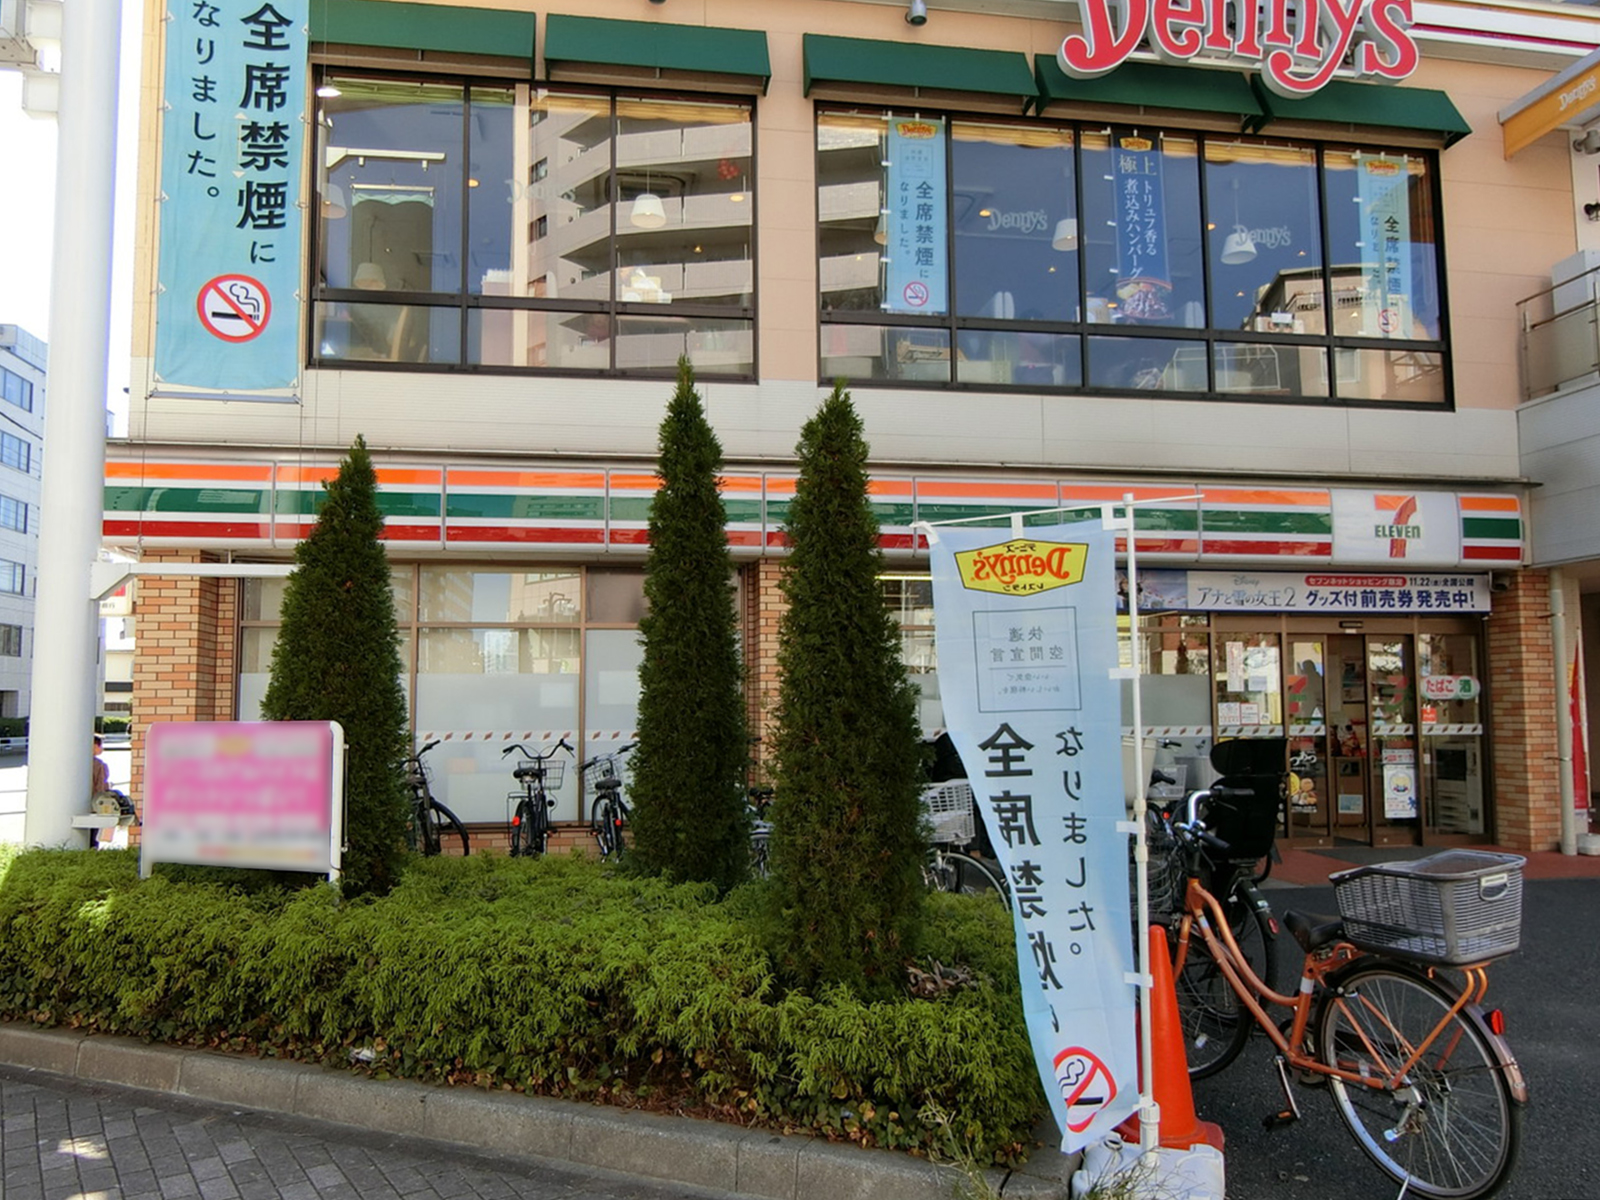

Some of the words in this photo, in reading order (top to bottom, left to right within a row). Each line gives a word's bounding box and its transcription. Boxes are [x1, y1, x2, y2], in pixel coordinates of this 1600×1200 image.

[1057, 0, 1420, 97] Dennys
[187, 0, 221, 199] なりました。
[236, 2, 294, 264] 全席禁煙に
[1119, 153, 1157, 176] 極上
[899, 180, 911, 256] なりました。
[914, 180, 935, 279] 全席禁煙に
[986, 207, 1048, 234] Denny's
[1124, 178, 1144, 281] 煮込みハンバーグ
[1142, 180, 1158, 256] トリュフ香る
[1232, 223, 1292, 250] Denny's
[1426, 678, 1455, 694] たばこ
